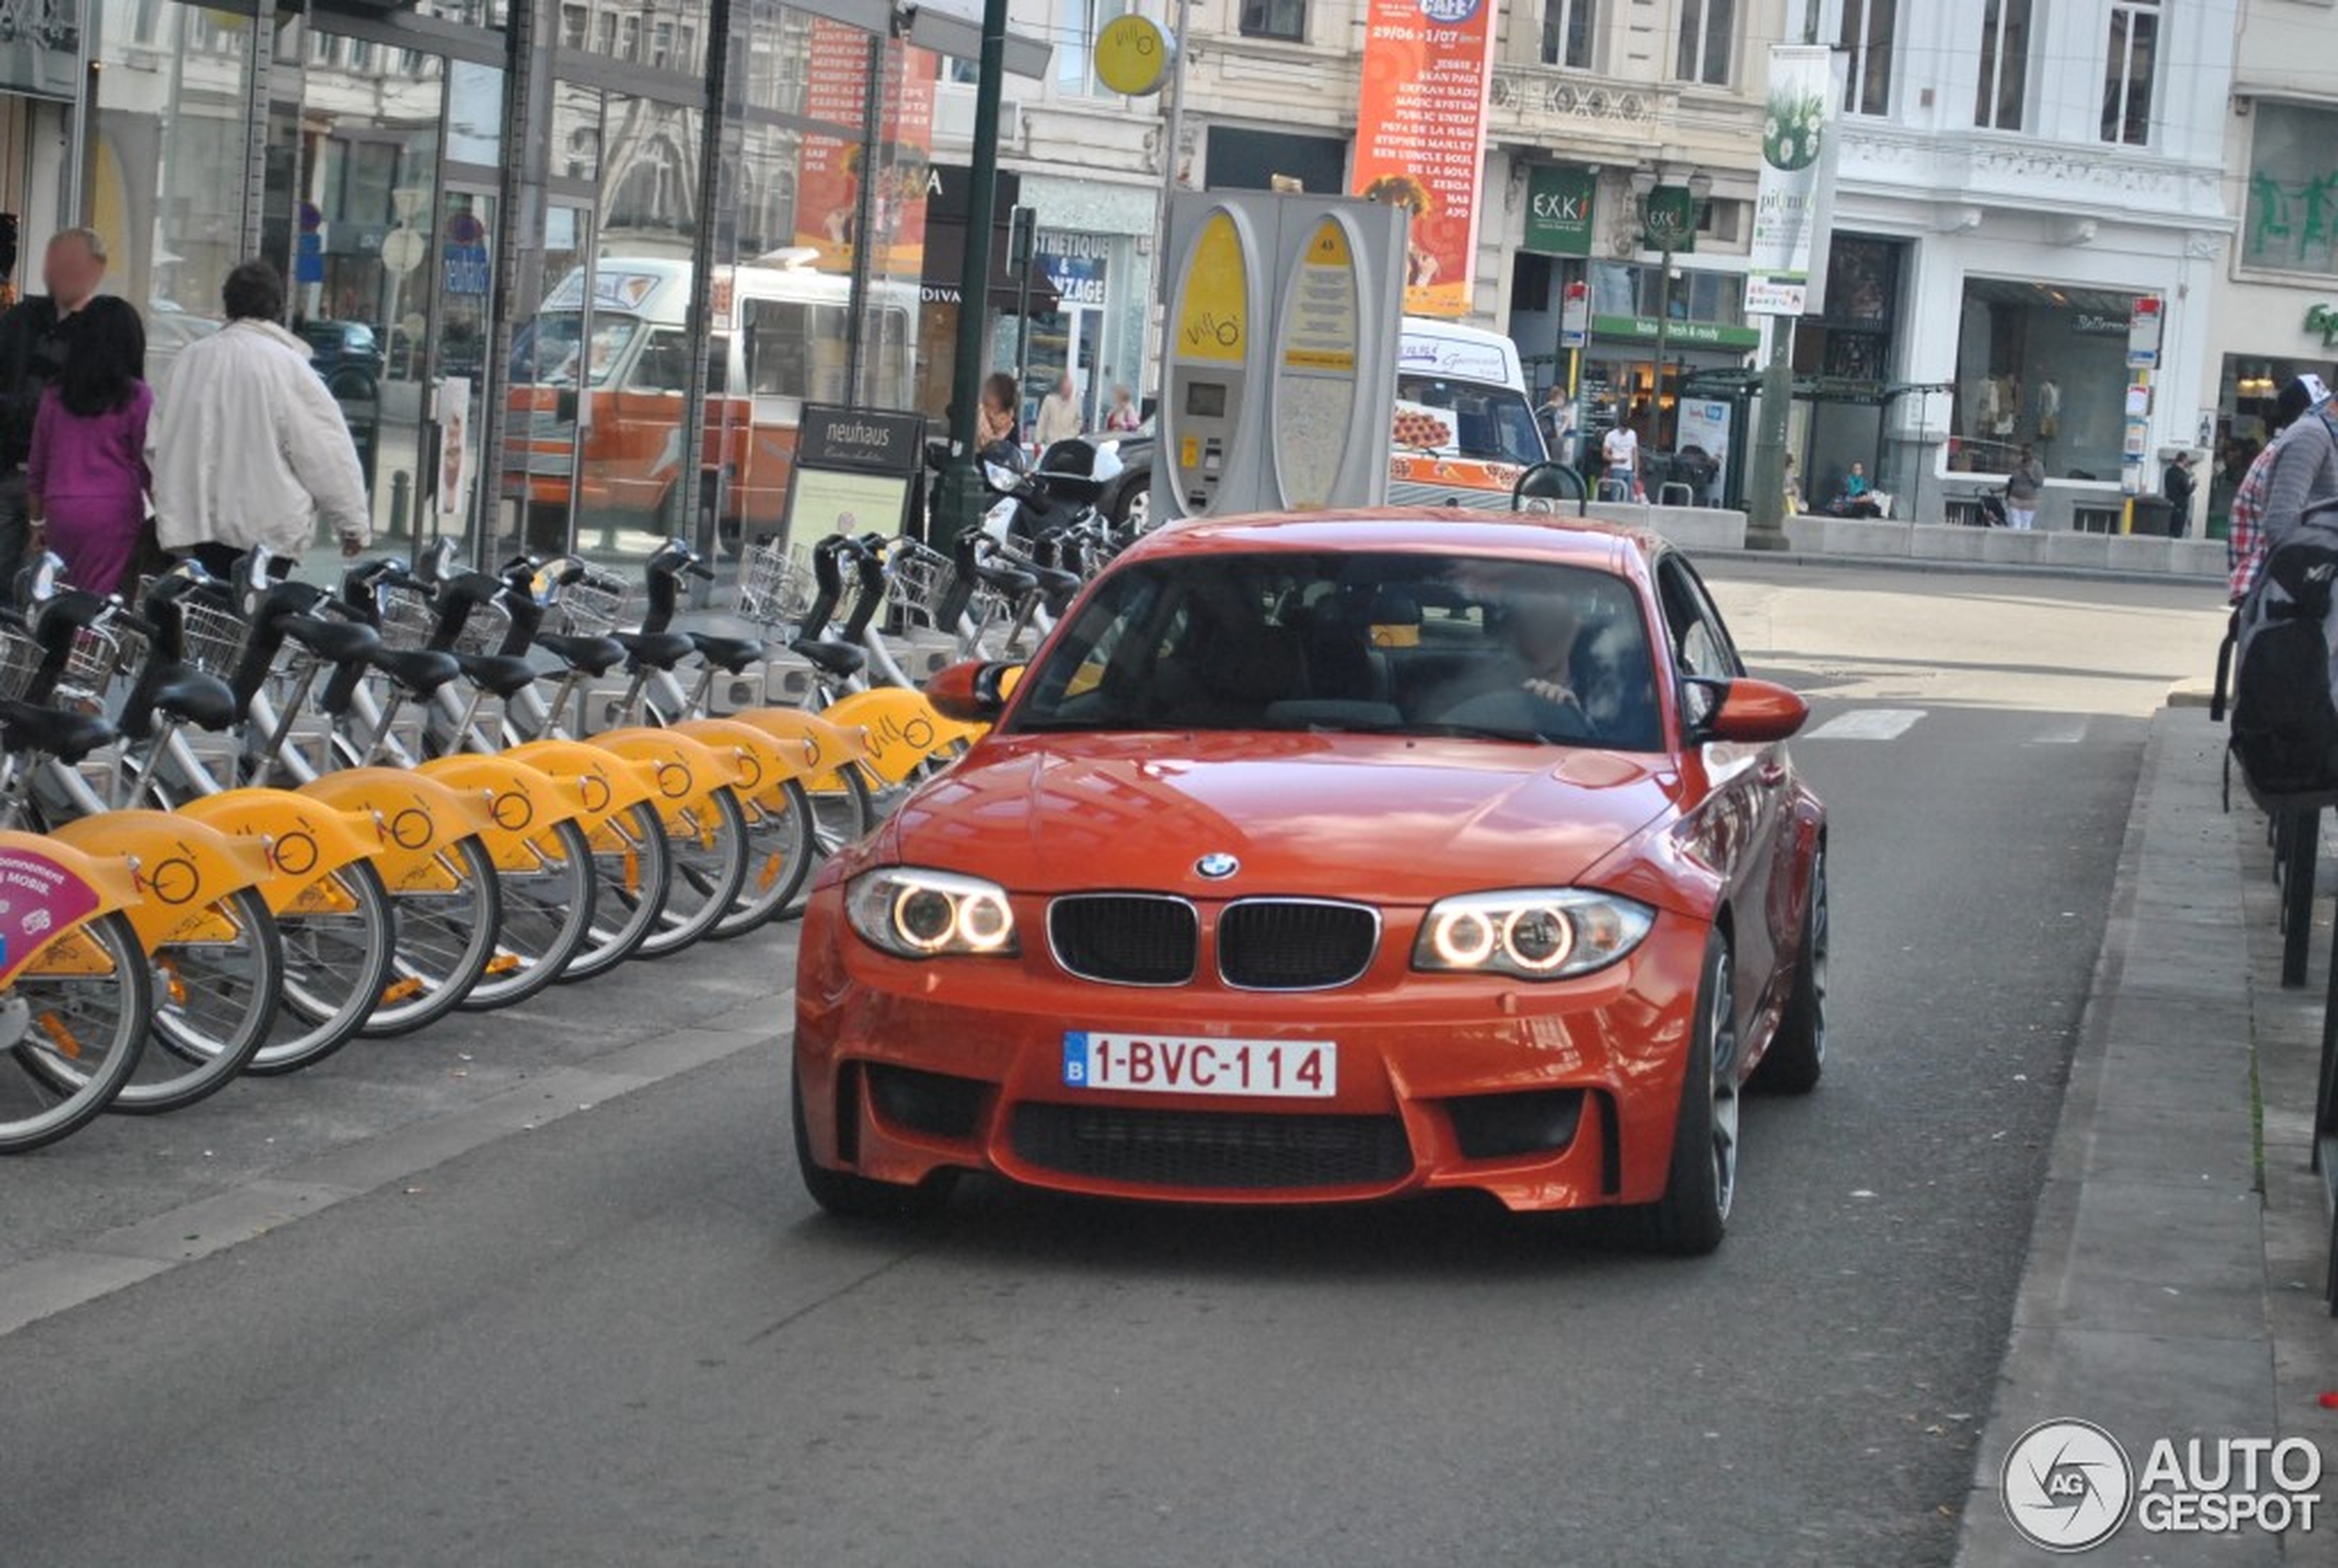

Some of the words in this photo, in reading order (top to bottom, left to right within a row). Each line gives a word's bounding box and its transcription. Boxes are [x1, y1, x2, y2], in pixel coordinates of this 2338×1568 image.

[1059, 258, 1070, 274] &
[827, 420, 891, 446] neuhaus
[1067, 1061, 1083, 1080] B
[1094, 1040, 1323, 1090] 1-BVC-114
